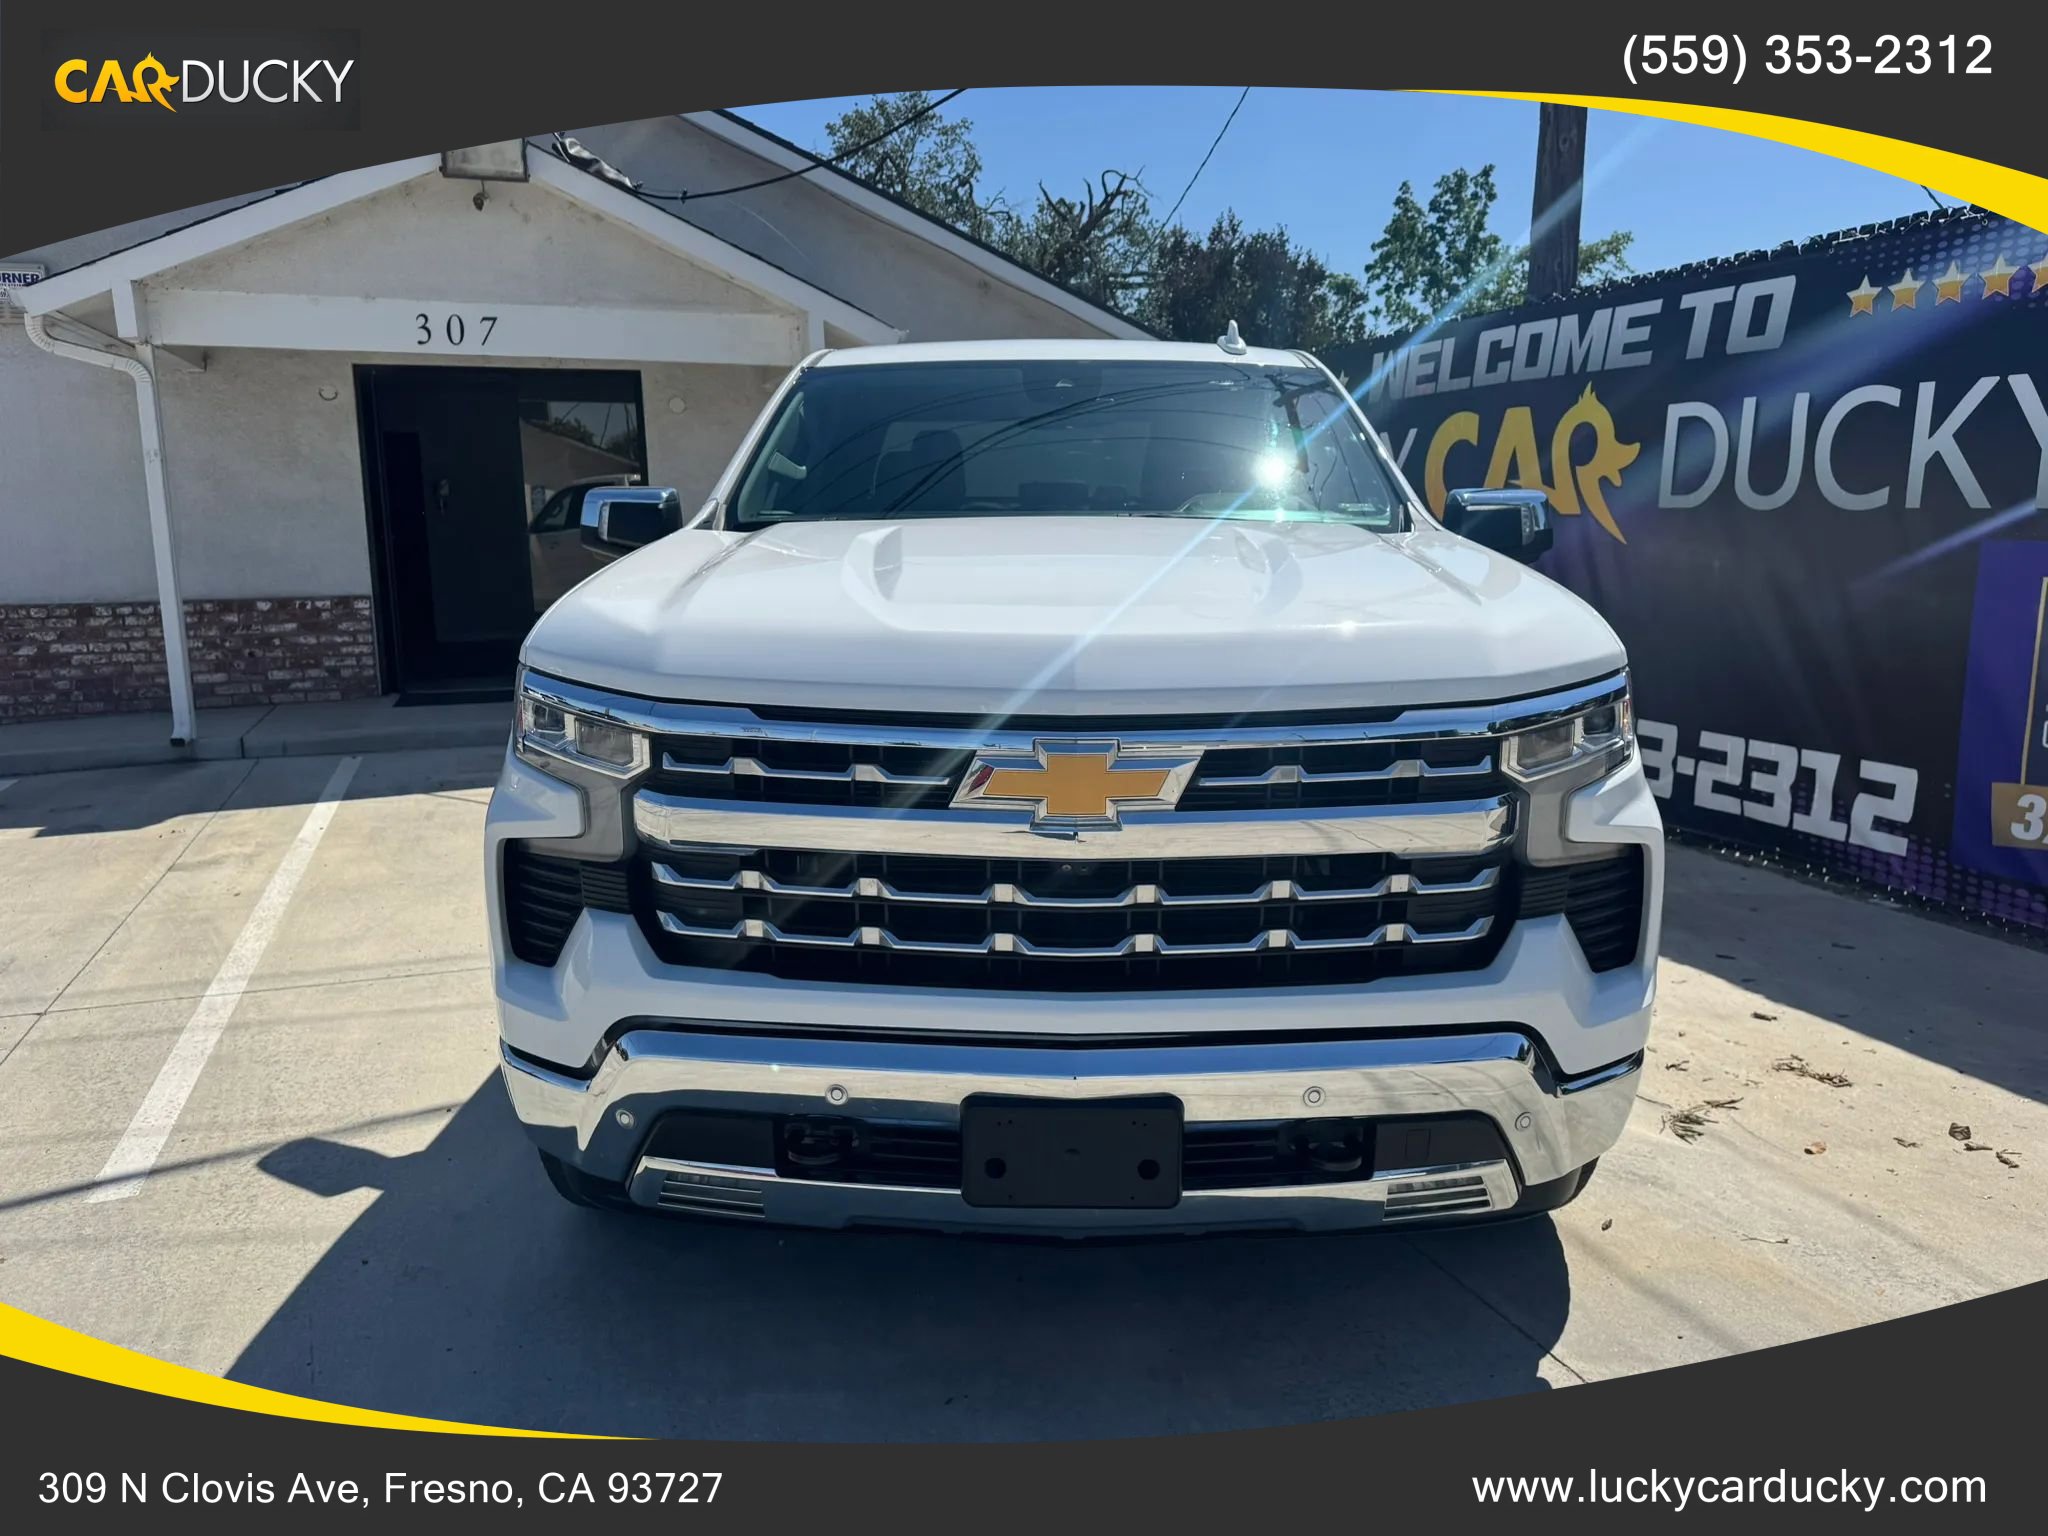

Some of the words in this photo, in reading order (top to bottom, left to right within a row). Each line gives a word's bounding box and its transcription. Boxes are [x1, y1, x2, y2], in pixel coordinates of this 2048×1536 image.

[0, 272, 40, 284] RNER
[415, 313, 499, 347] 307
[1367, 299, 1661, 404] WELCOME
[1679, 275, 1797, 360] TO
